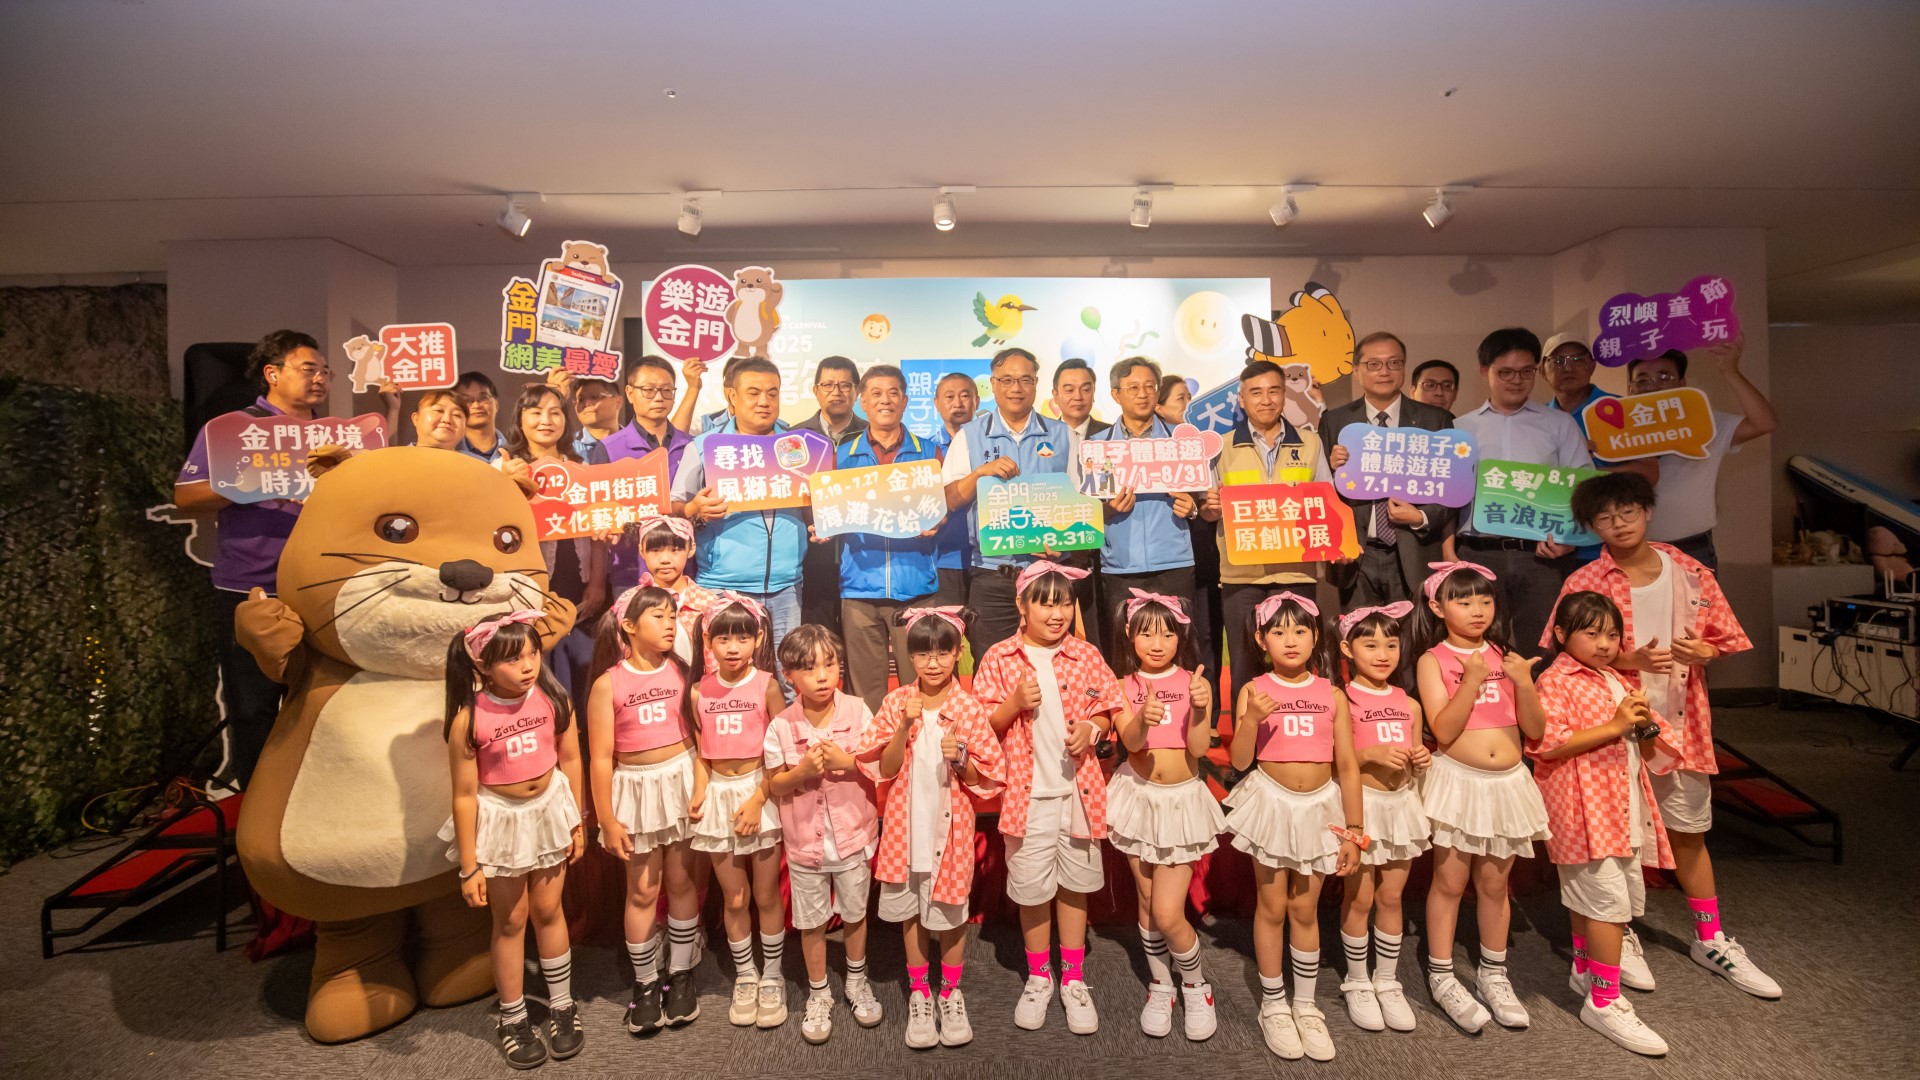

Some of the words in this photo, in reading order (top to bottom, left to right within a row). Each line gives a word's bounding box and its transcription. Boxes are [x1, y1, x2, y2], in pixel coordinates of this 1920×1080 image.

[660, 277, 730, 317] 樂遊
[506, 282, 538, 343] 金門
[391, 331, 445, 357] 大推
[658, 314, 725, 352] 金門
[772, 335, 813, 353] 025
[392, 358, 446, 383] 金門
[505, 344, 619, 379] 網美最愛
[1629, 397, 1686, 428] 金門
[238, 423, 364, 450] 金門秘境
[1362, 430, 1453, 457] 金門親子
[1609, 427, 1693, 451] Kinmen
[252, 453, 291, 467] 8.15
[713, 444, 765, 470] 尋找
[1081, 440, 1202, 464] 親子體驗遊
[1361, 452, 1451, 479] 體驗遊程
[537, 475, 564, 488] 7.12
[566, 475, 658, 505] 金門街頭
[717, 474, 792, 502] 風獅爺
[886, 466, 934, 492] 金湖
[1364, 476, 1389, 493] 7.1
[1407, 480, 1444, 497] 8.31
[987, 483, 1029, 506] 金門
[1033, 492, 1058, 502] 2025
[988, 502, 1094, 530] 親子嘉年華
[1231, 497, 1326, 523] 巨型金門
[1235, 524, 1332, 552] 原創IP展
[649, 687, 679, 698] Clover
[728, 699, 758, 710] Clover
[1155, 690, 1184, 700] Clover
[638, 701, 667, 725] 05
[1295, 699, 1329, 712] Clover
[1384, 707, 1410, 719] Clover
[517, 716, 548, 728] Clover
[716, 714, 743, 735] 05
[1283, 715, 1314, 736] 05
[1376, 722, 1405, 743] 05
[506, 731, 538, 758] 05
